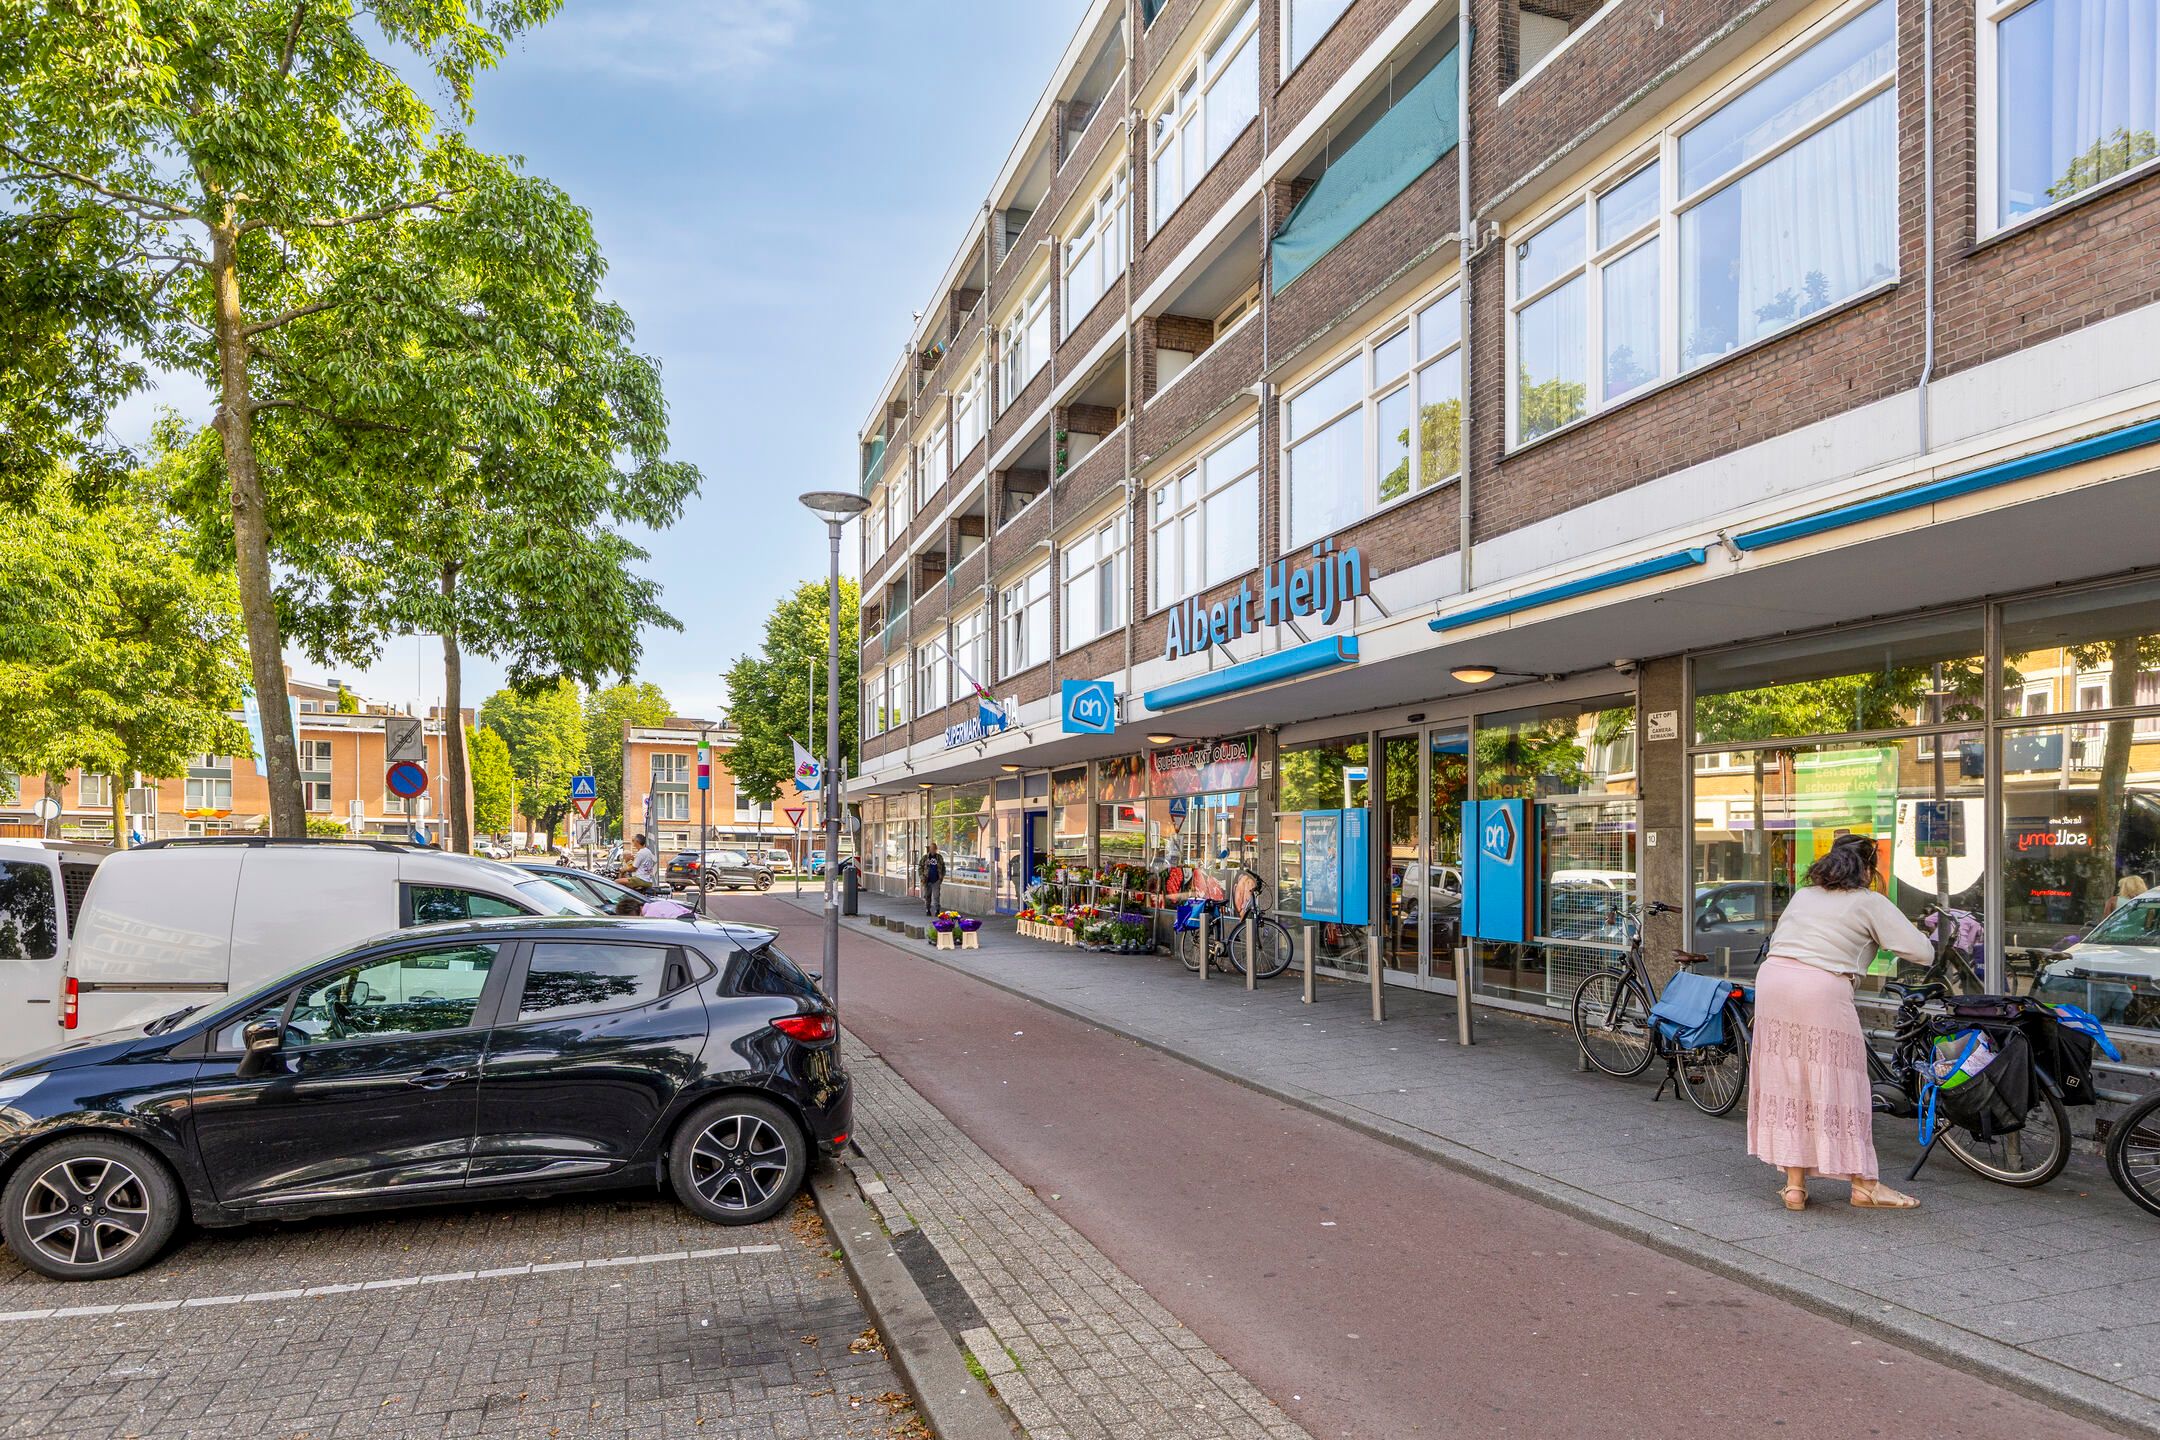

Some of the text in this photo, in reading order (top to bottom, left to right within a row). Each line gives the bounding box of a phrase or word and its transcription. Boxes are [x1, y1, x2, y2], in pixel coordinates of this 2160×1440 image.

[1165, 537, 1369, 662] Albert Heijn
[1156, 742, 1248, 771] SUPERMARKT OUJDA
[1815, 764, 1878, 778] Een stapje
[1805, 779, 1888, 793] schoner leven
